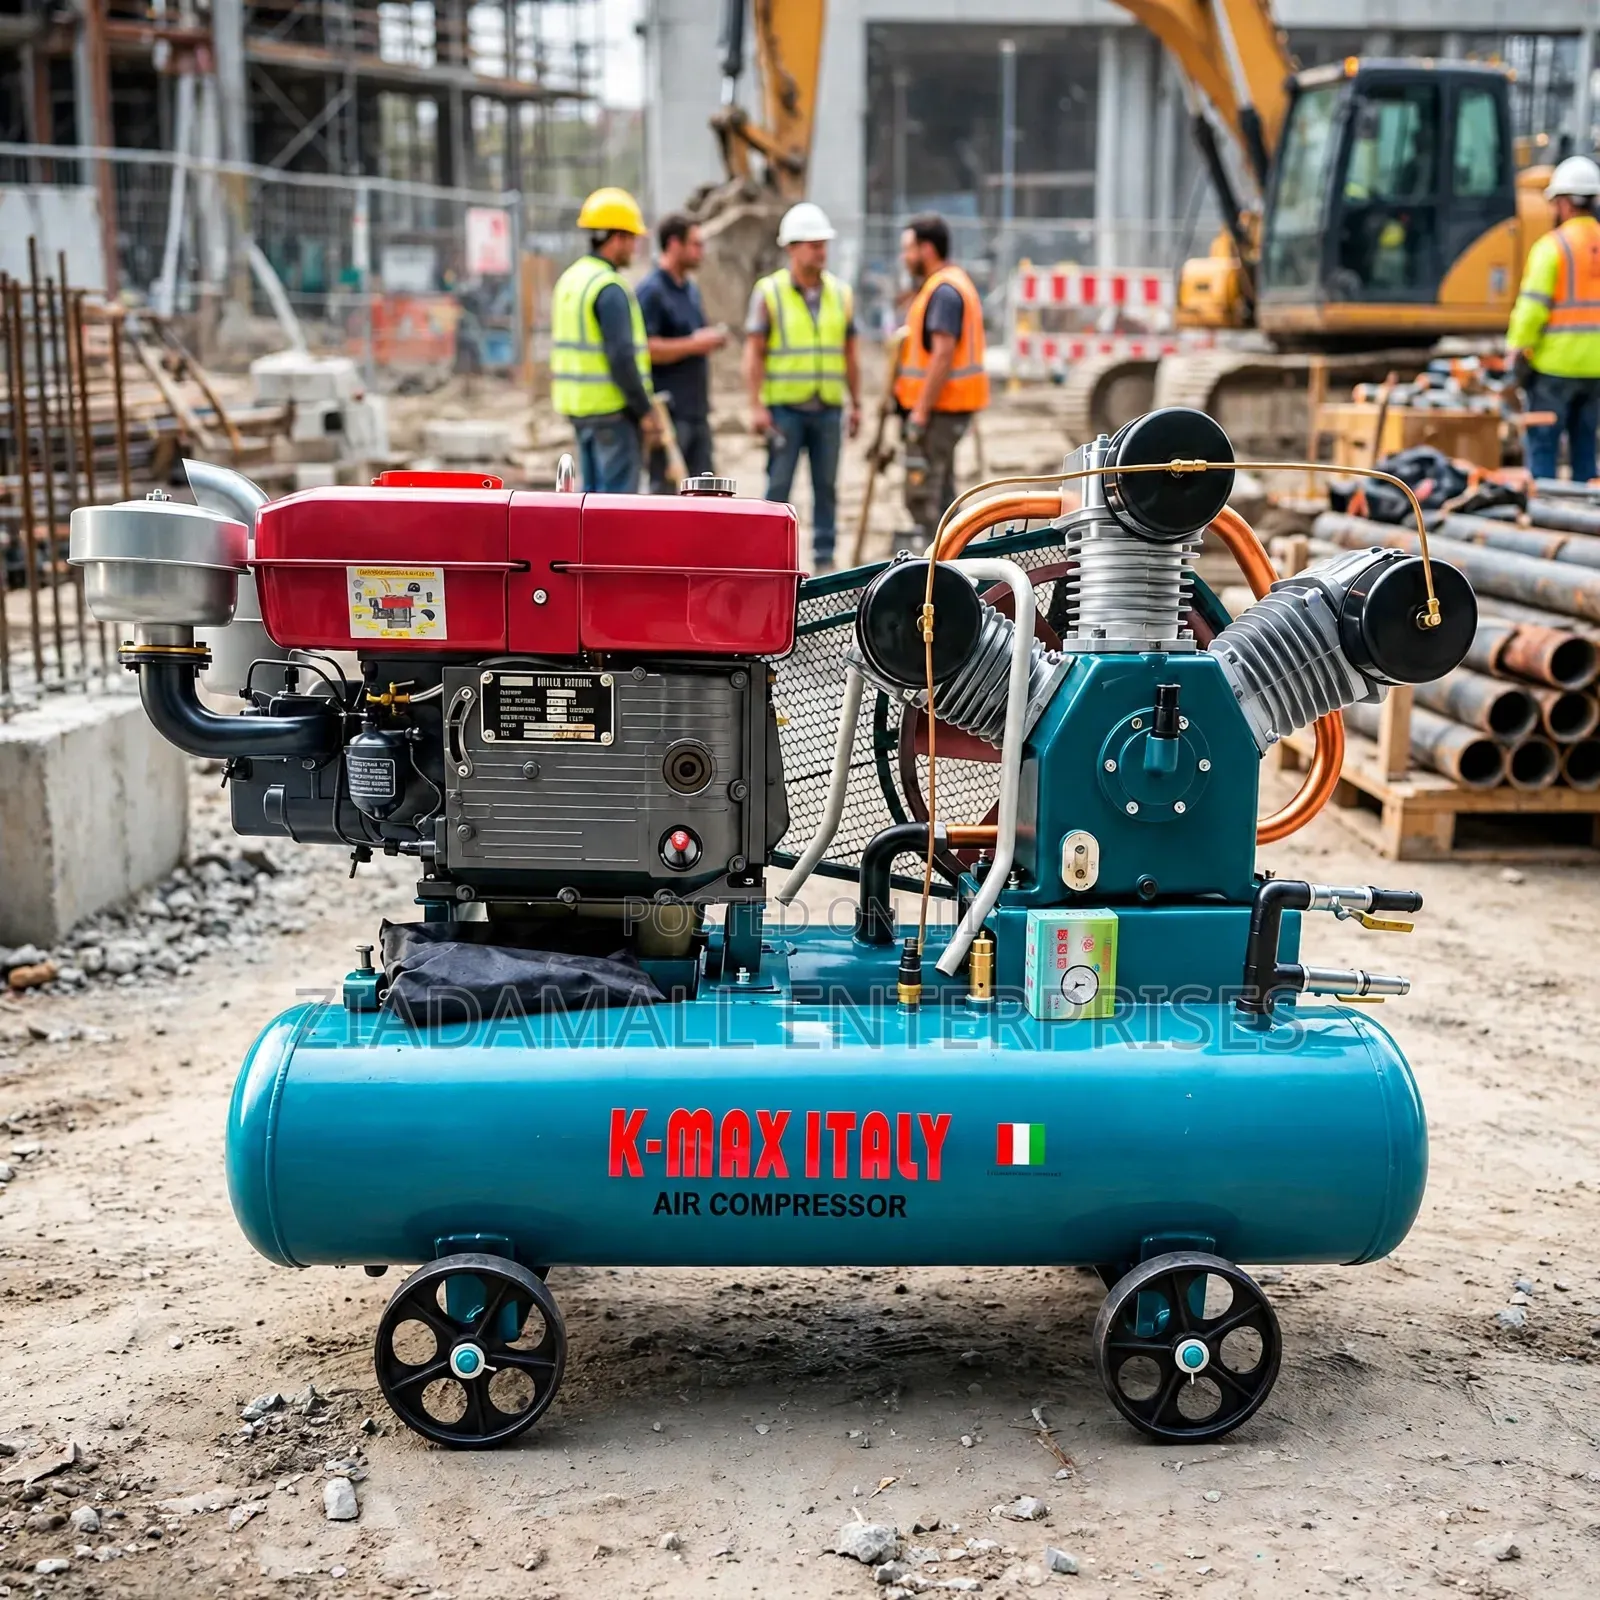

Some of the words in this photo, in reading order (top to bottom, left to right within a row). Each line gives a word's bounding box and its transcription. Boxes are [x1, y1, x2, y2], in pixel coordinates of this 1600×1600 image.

[608, 1107, 791, 1178] K-MAX
[804, 1110, 953, 1180] ITALY
[652, 1191, 702, 1216] AIR
[709, 1192, 908, 1218] COMPRESSOR
